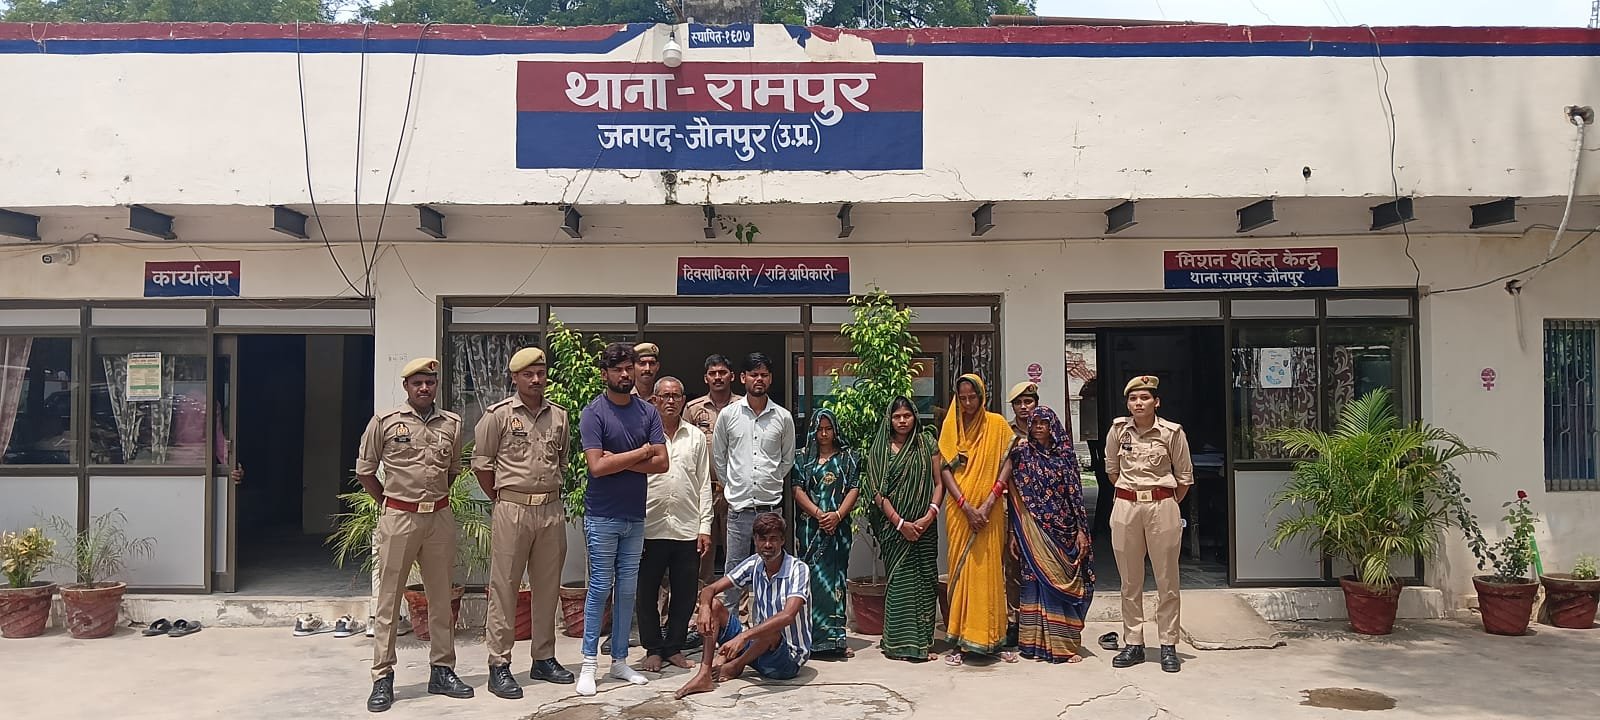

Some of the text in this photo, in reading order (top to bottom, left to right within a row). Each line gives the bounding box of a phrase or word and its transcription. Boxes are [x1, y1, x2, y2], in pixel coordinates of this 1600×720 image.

[565, 72, 675, 110] थाना
[704, 73, 877, 126] रामपुर
[1176, 249, 1321, 272] मिशन शक्ति केन्द्र
[151, 264, 233, 287] कार्यालय
